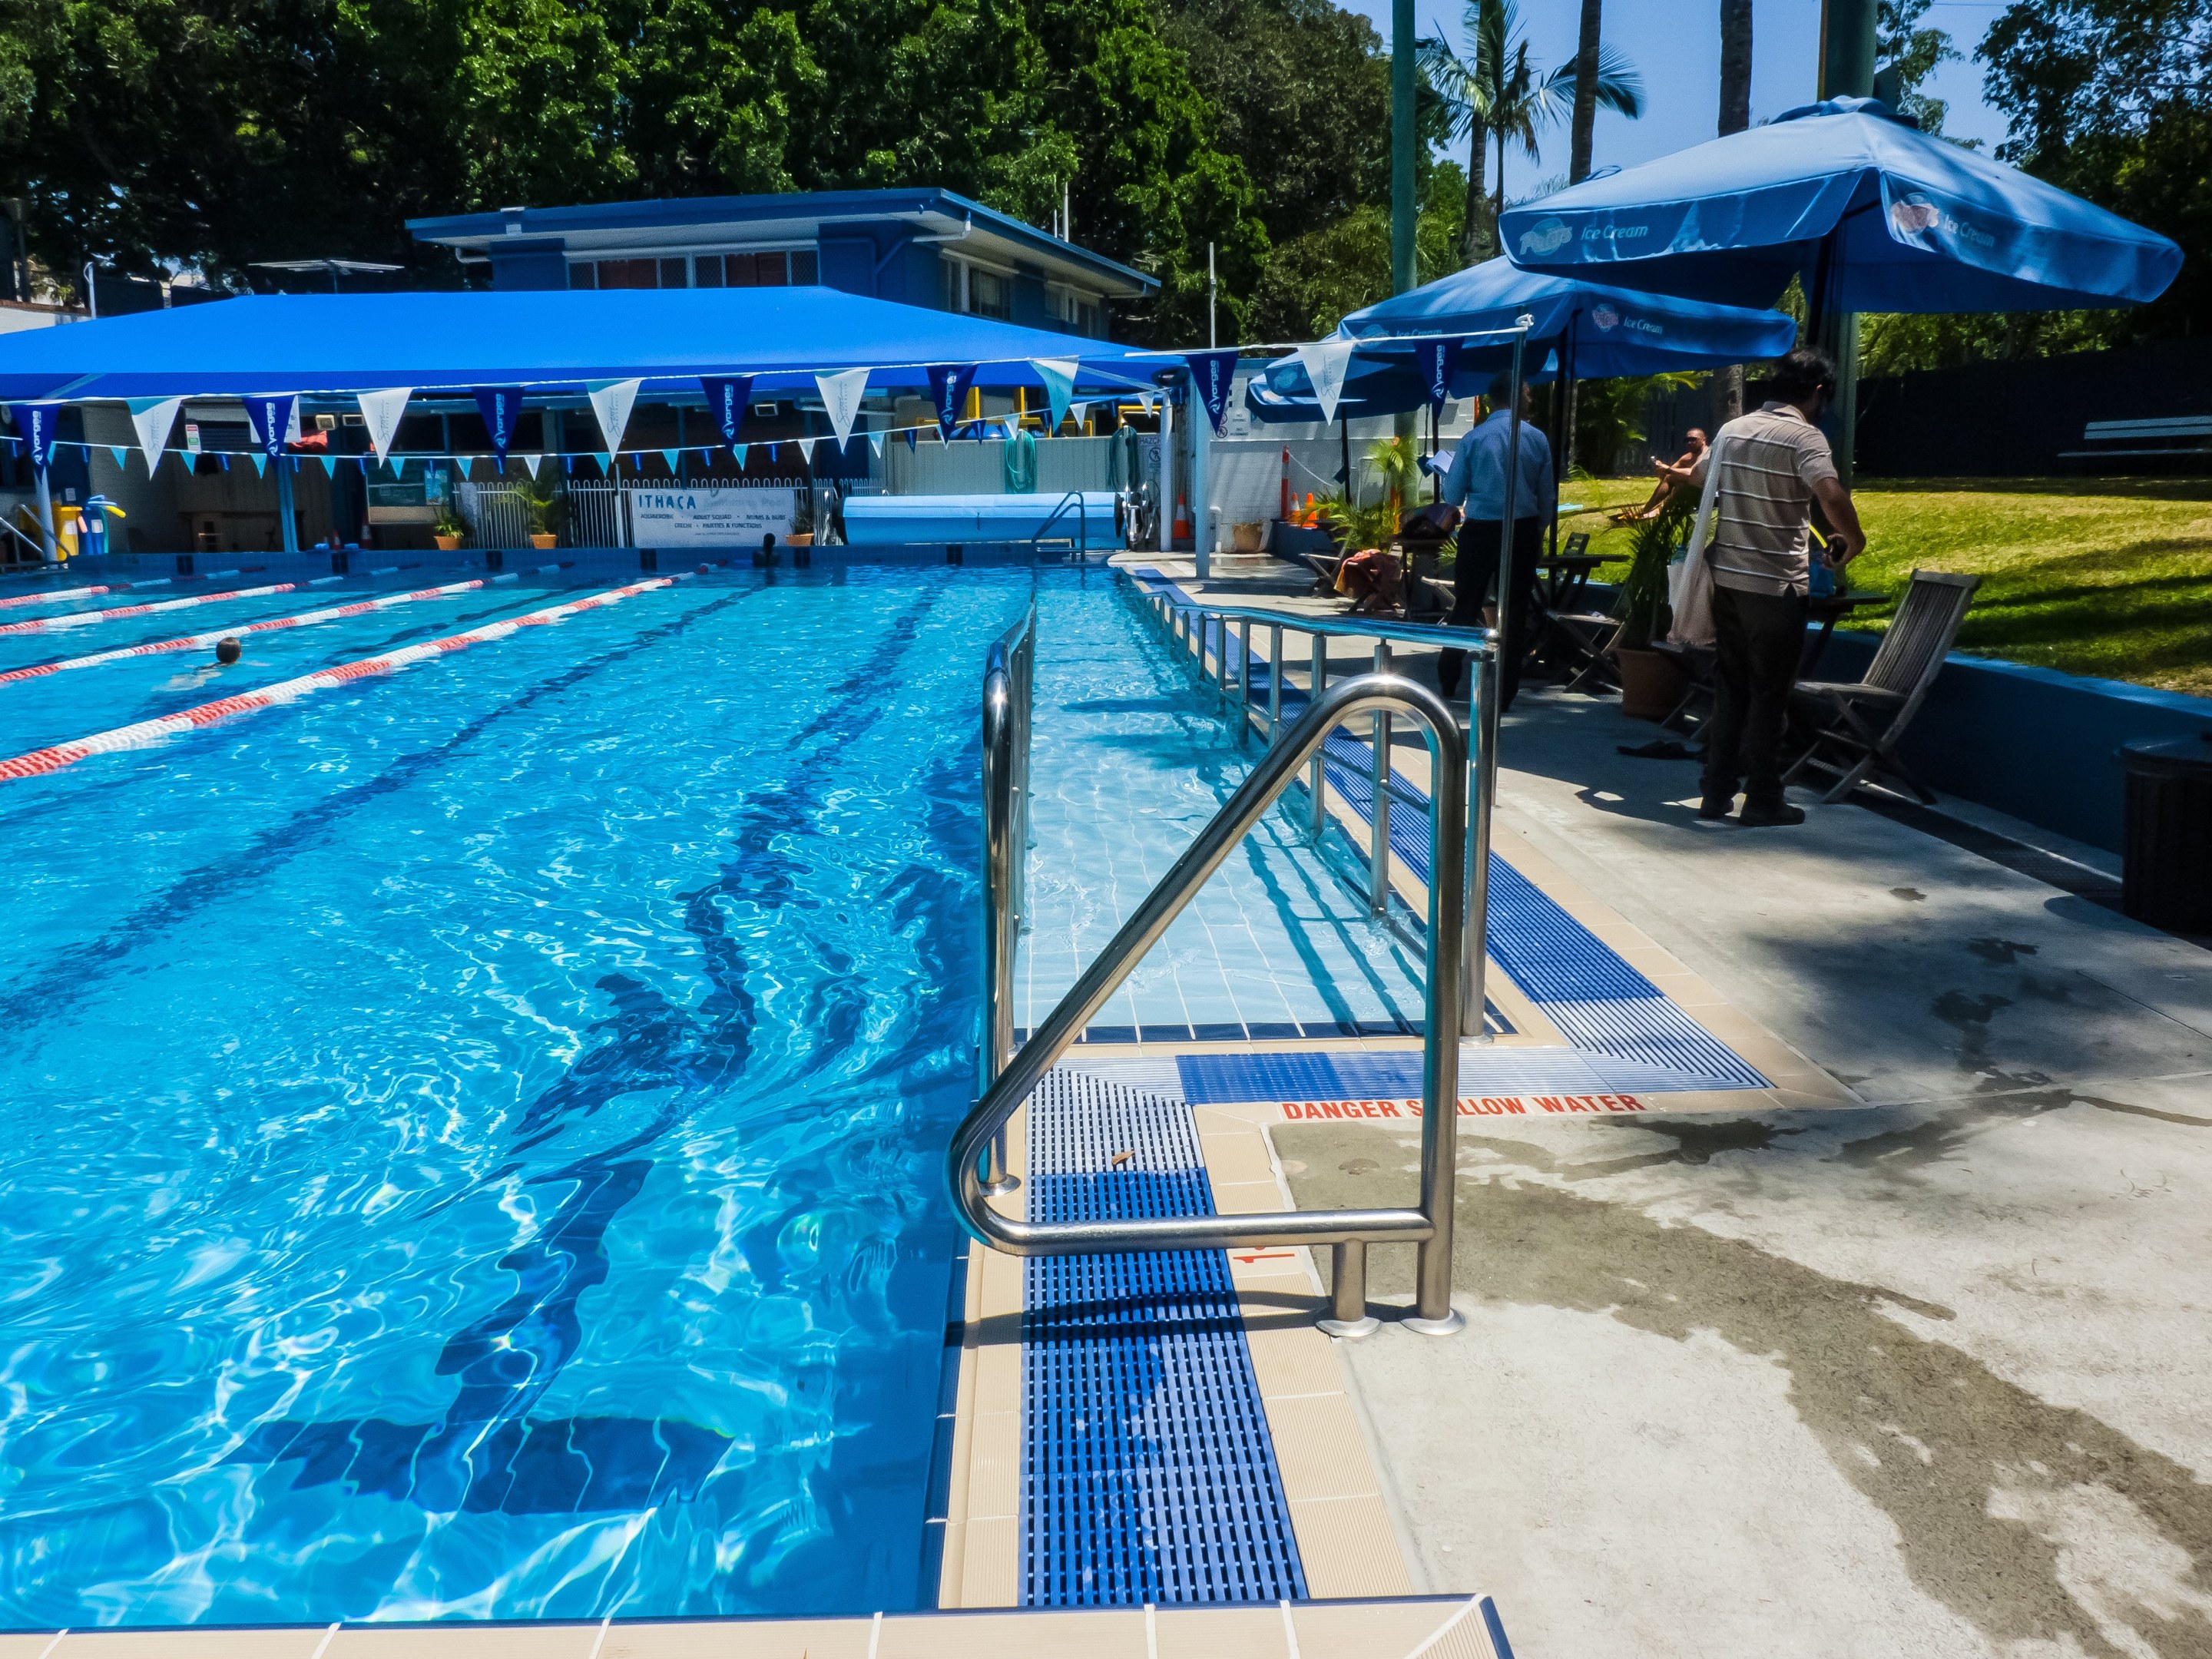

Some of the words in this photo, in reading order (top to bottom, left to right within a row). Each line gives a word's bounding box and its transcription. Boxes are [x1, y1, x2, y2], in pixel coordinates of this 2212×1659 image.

[1581, 227, 1601, 240] Ice
[1602, 224, 1649, 239] Cream
[1945, 214, 1959, 234] Ice
[1960, 221, 1995, 248] Cream
[1623, 316, 1637, 329] Ice
[1637, 319, 1663, 335] Cream
[1208, 359, 1220, 407] Vorgee
[722, 384, 733, 430] Vorgee
[638, 495, 697, 510] ITHACA
[1281, 1100, 1402, 1121] DANGER
[1406, 1097, 1527, 1118] SLLOW
[1531, 1094, 1647, 1113] WATER
